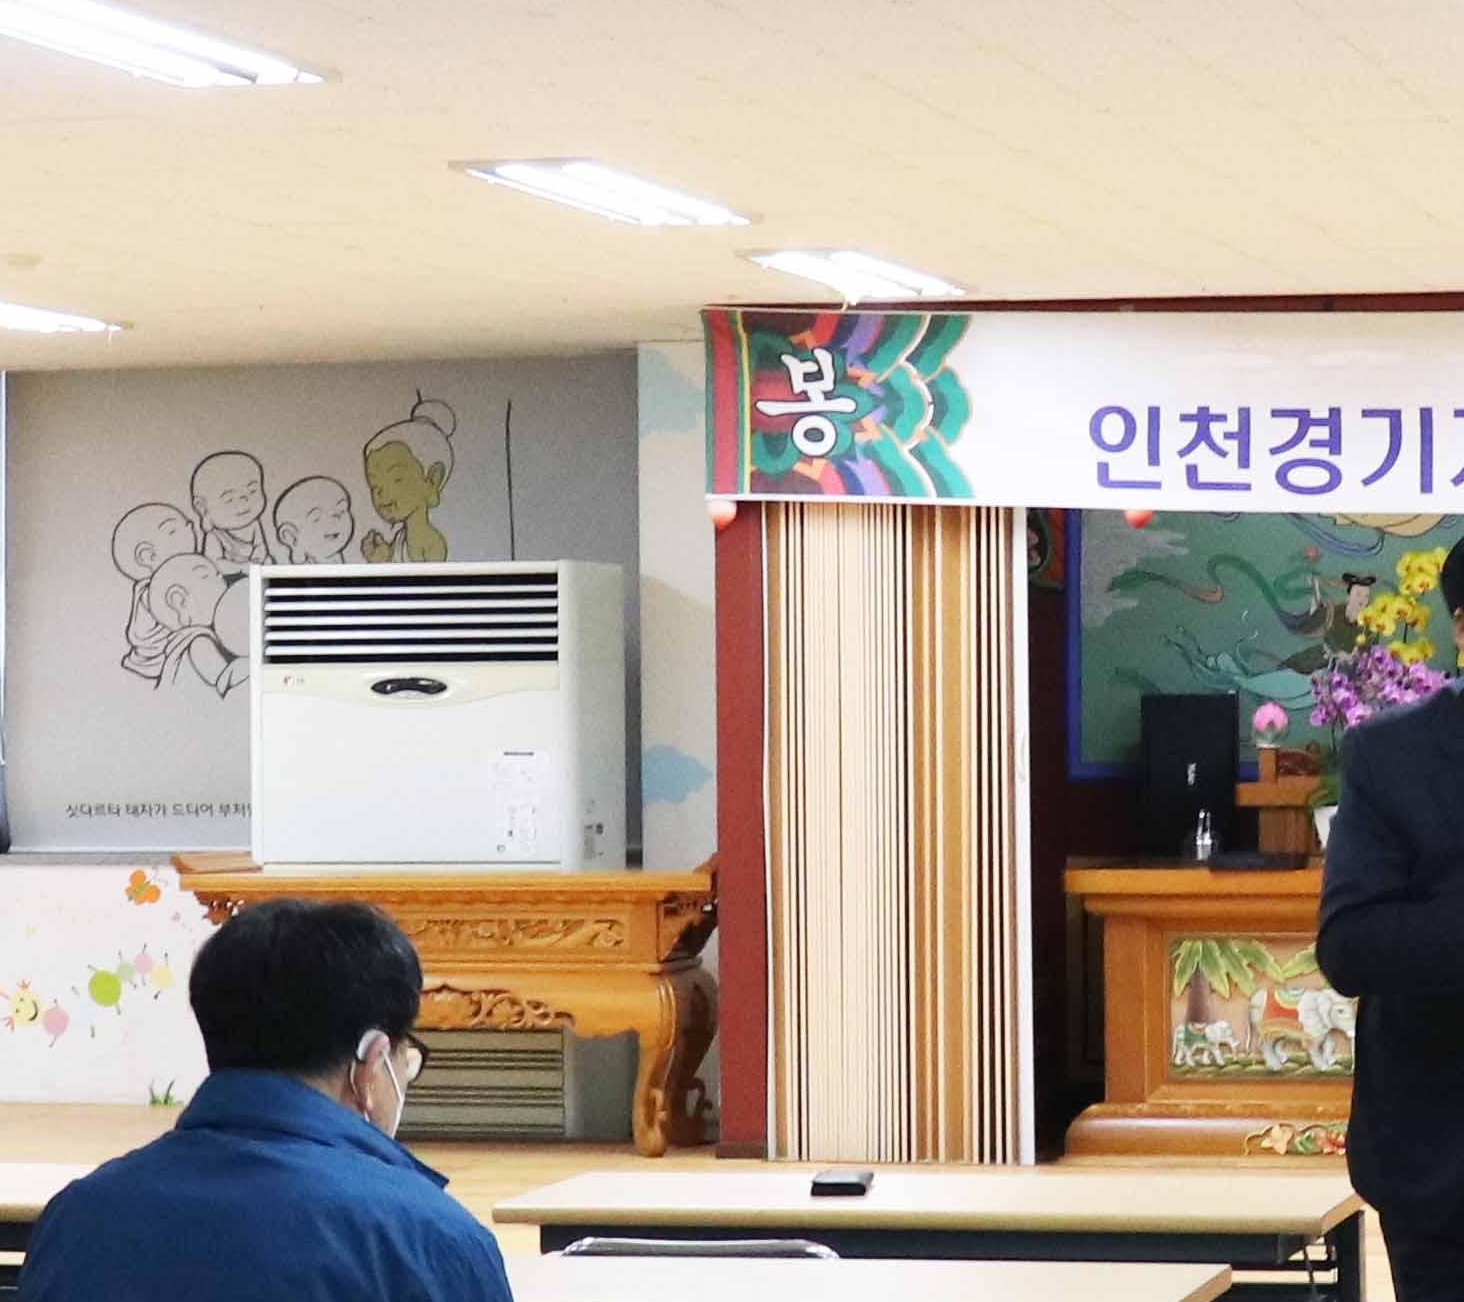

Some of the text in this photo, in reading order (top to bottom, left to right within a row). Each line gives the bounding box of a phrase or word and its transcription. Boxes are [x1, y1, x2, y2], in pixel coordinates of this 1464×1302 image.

[755, 347, 858, 457] 봉
[65, 802, 121, 819] 싯다르타
[125, 802, 167, 819] 태자가
[172, 802, 214, 818] 드디어
